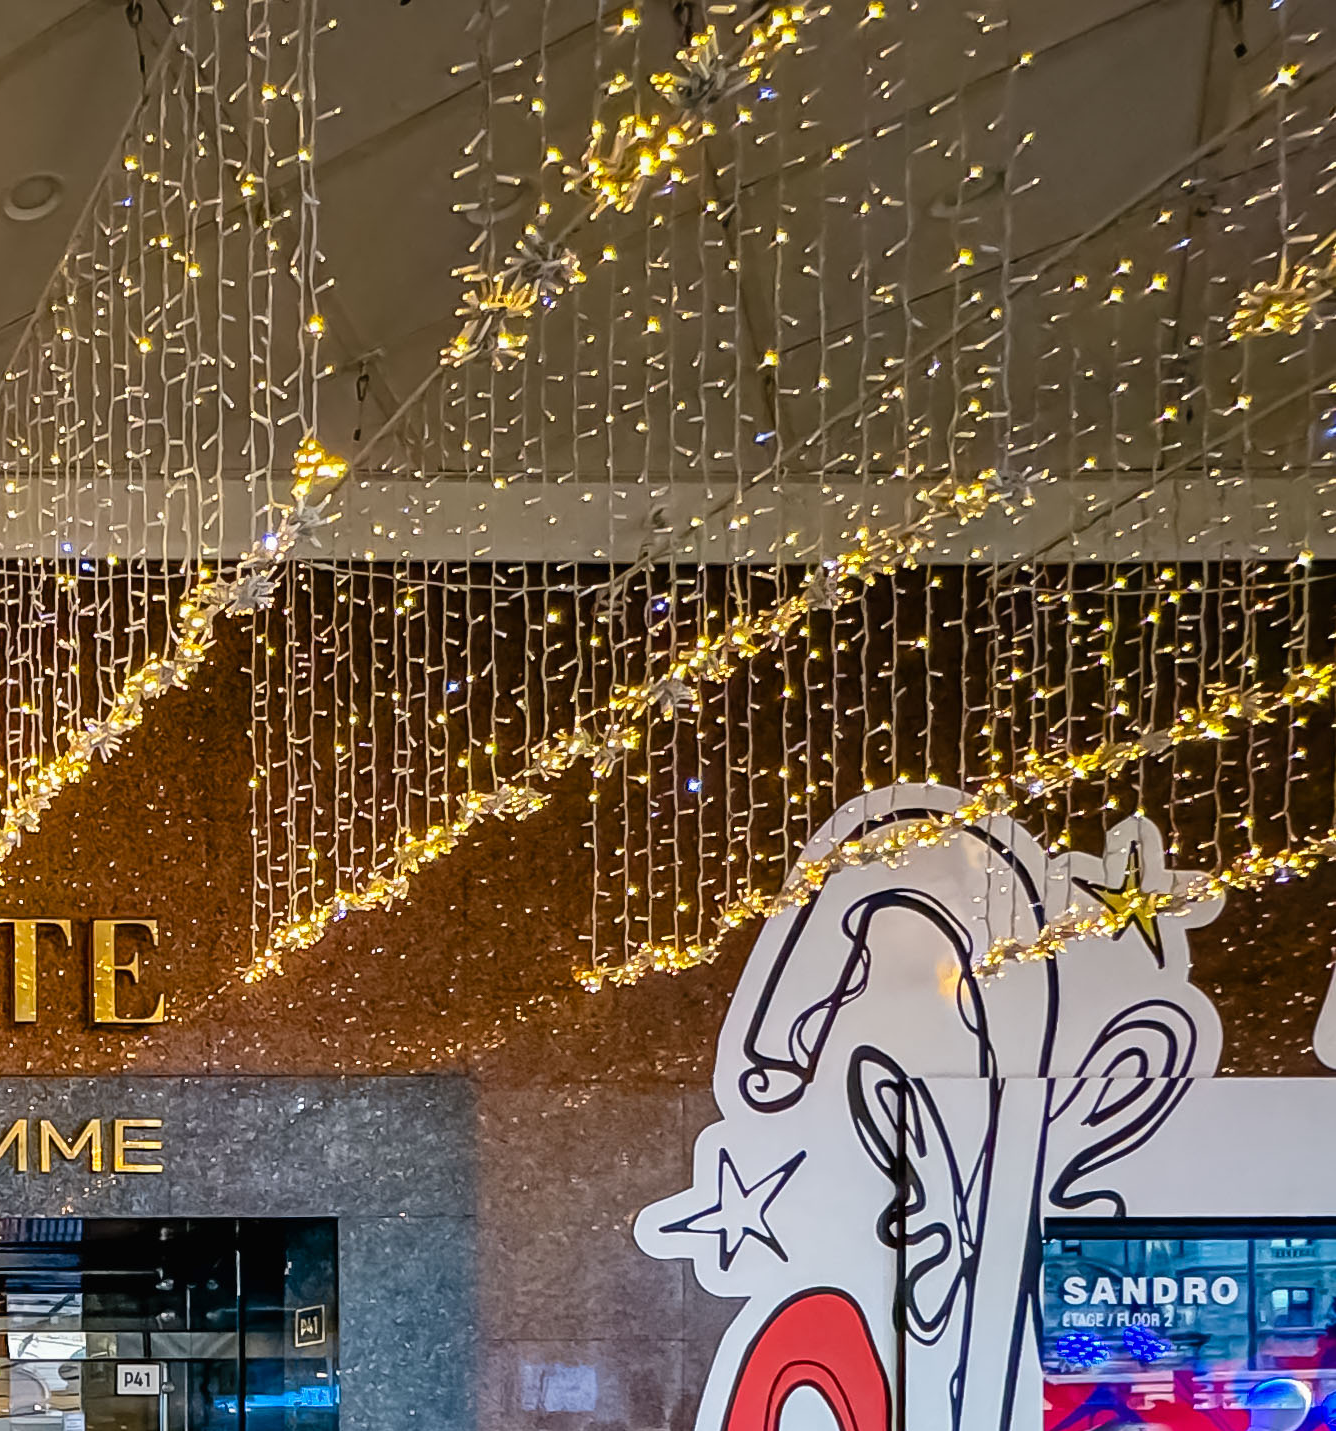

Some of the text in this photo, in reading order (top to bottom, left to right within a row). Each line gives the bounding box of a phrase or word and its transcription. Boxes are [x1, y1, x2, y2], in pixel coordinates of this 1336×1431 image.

[1063, 1276, 1239, 1305] SANDRO
[1117, 1313, 1160, 1327] FLOOR
[124, 1371, 151, 1388] P41
